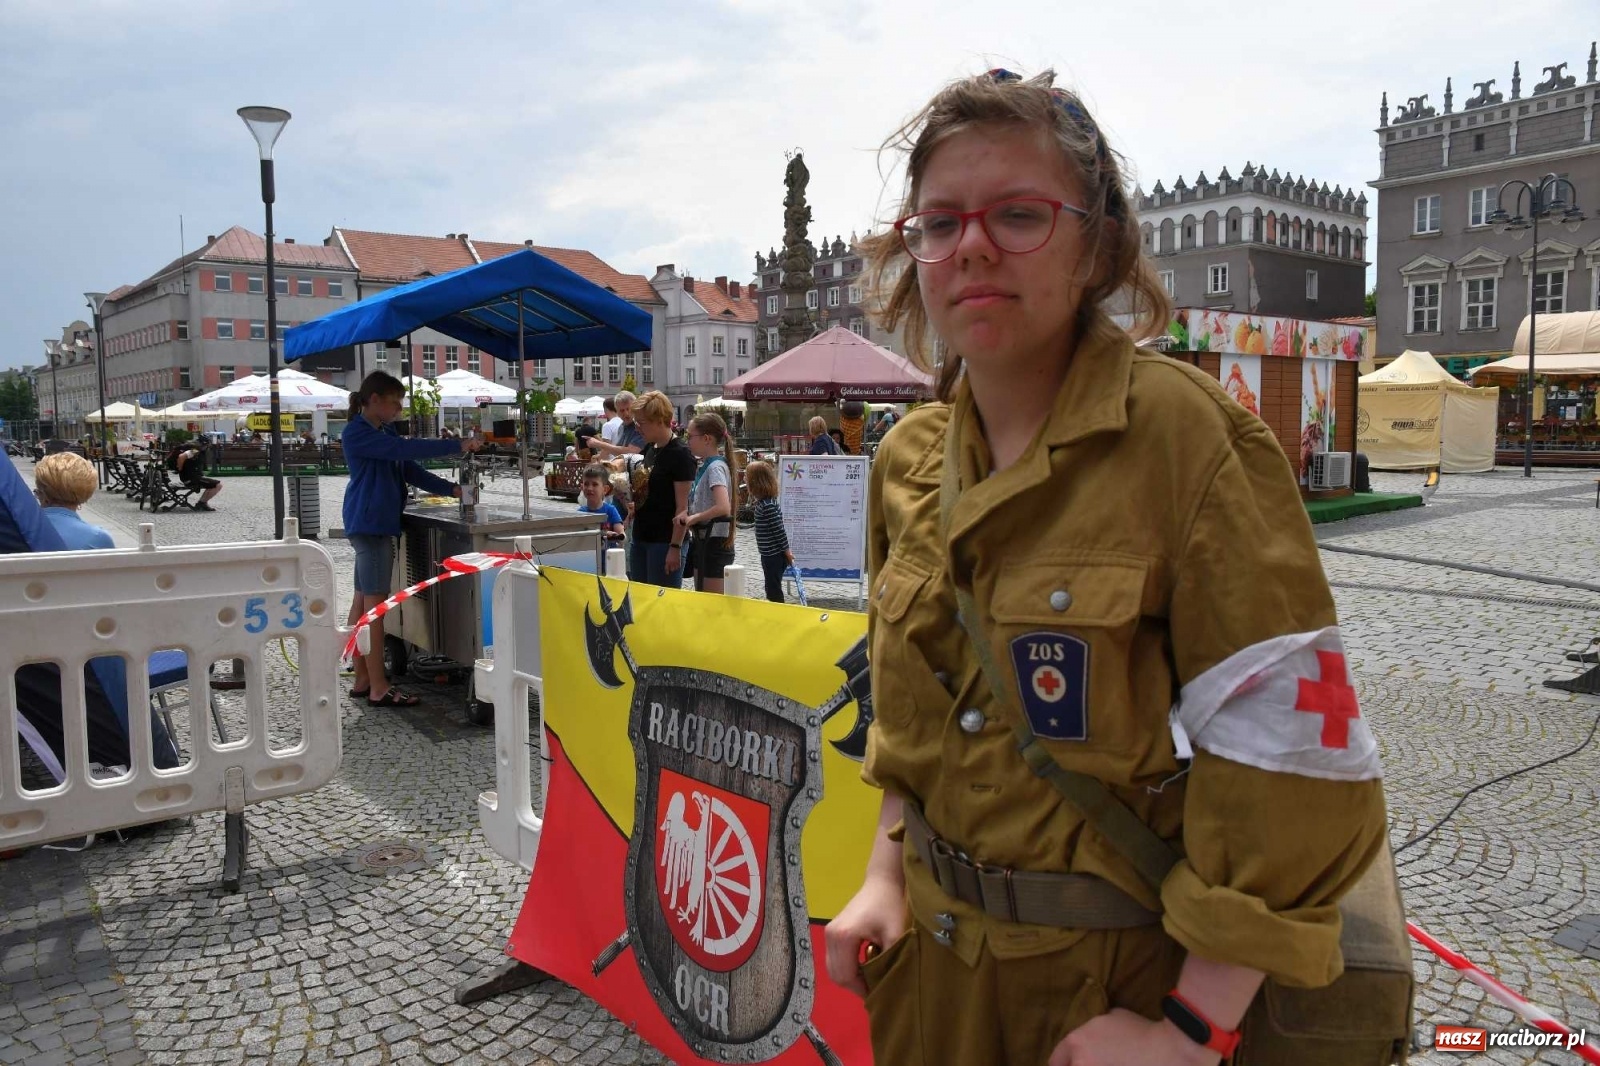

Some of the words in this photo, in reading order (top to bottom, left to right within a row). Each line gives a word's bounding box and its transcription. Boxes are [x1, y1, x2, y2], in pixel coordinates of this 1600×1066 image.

[752, 386, 784, 397] Gelateria
[785, 387, 801, 396] Ciao
[802, 386, 825, 395] Italia
[840, 386, 874, 396] Gelateria
[875, 386, 893, 395] Ciao
[894, 386, 917, 395] Italia
[1027, 642, 1065, 661] ZOS
[675, 964, 730, 1036] OCR
